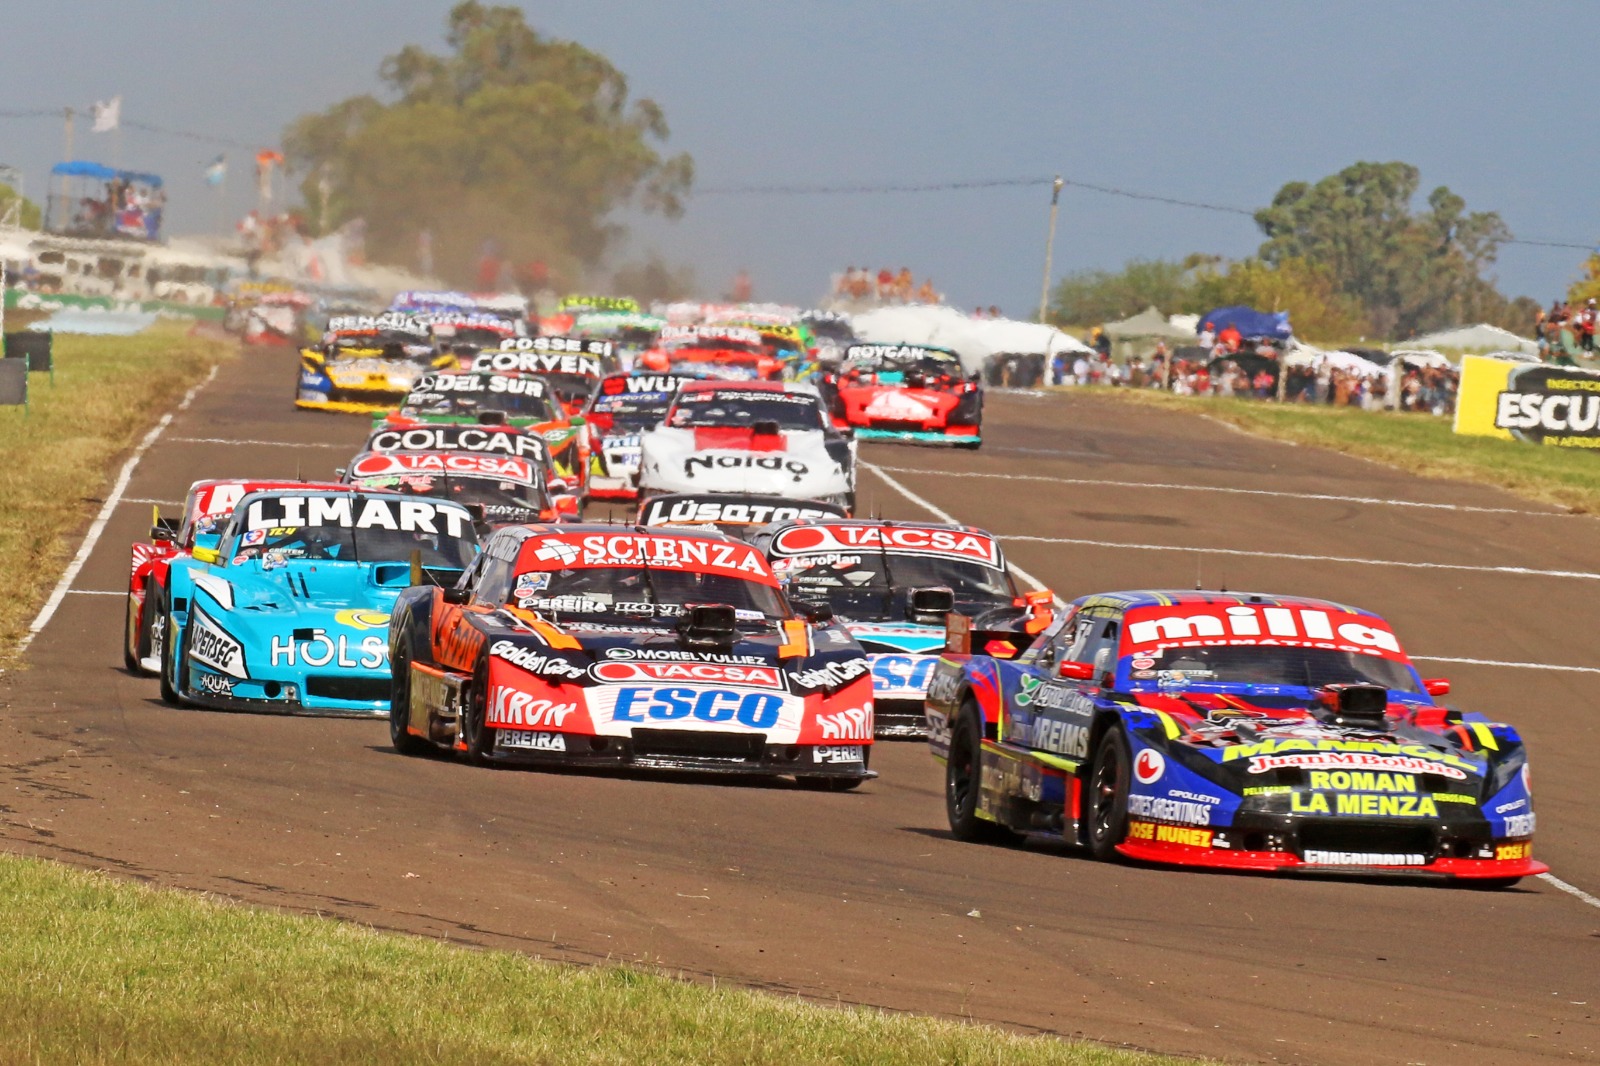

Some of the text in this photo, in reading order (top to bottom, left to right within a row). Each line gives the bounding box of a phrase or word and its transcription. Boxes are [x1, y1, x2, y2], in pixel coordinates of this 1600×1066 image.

[471, 352, 601, 377] CORVEN
[489, 375, 543, 397] SUR
[1497, 393, 1600, 431] ESCU
[373, 430, 543, 461] COLCAR
[406, 455, 526, 476] TACSA
[684, 456, 808, 482] Naldo
[248, 497, 472, 538] LIMART
[839, 526, 988, 557] TACSA
[583, 536, 767, 577] SCIENZA
[584, 558, 683, 568] FARMACIA
[789, 554, 861, 569] AgroPlan
[518, 597, 608, 613] PEREIRA
[1128, 606, 1401, 653] milla
[490, 640, 586, 679] Golden Cars
[636, 650, 767, 666] MOREL VULLIEZ
[201, 674, 236, 693] AQUA
[647, 664, 778, 685] TACSA
[487, 685, 577, 727] AKRON
[612, 687, 784, 729] ESCO
[495, 729, 566, 751] PEREIRA
[1310, 771, 1416, 792] ROMAN
[1290, 792, 1438, 817] LA MENZA
[1496, 843, 1523, 860] JOSE
